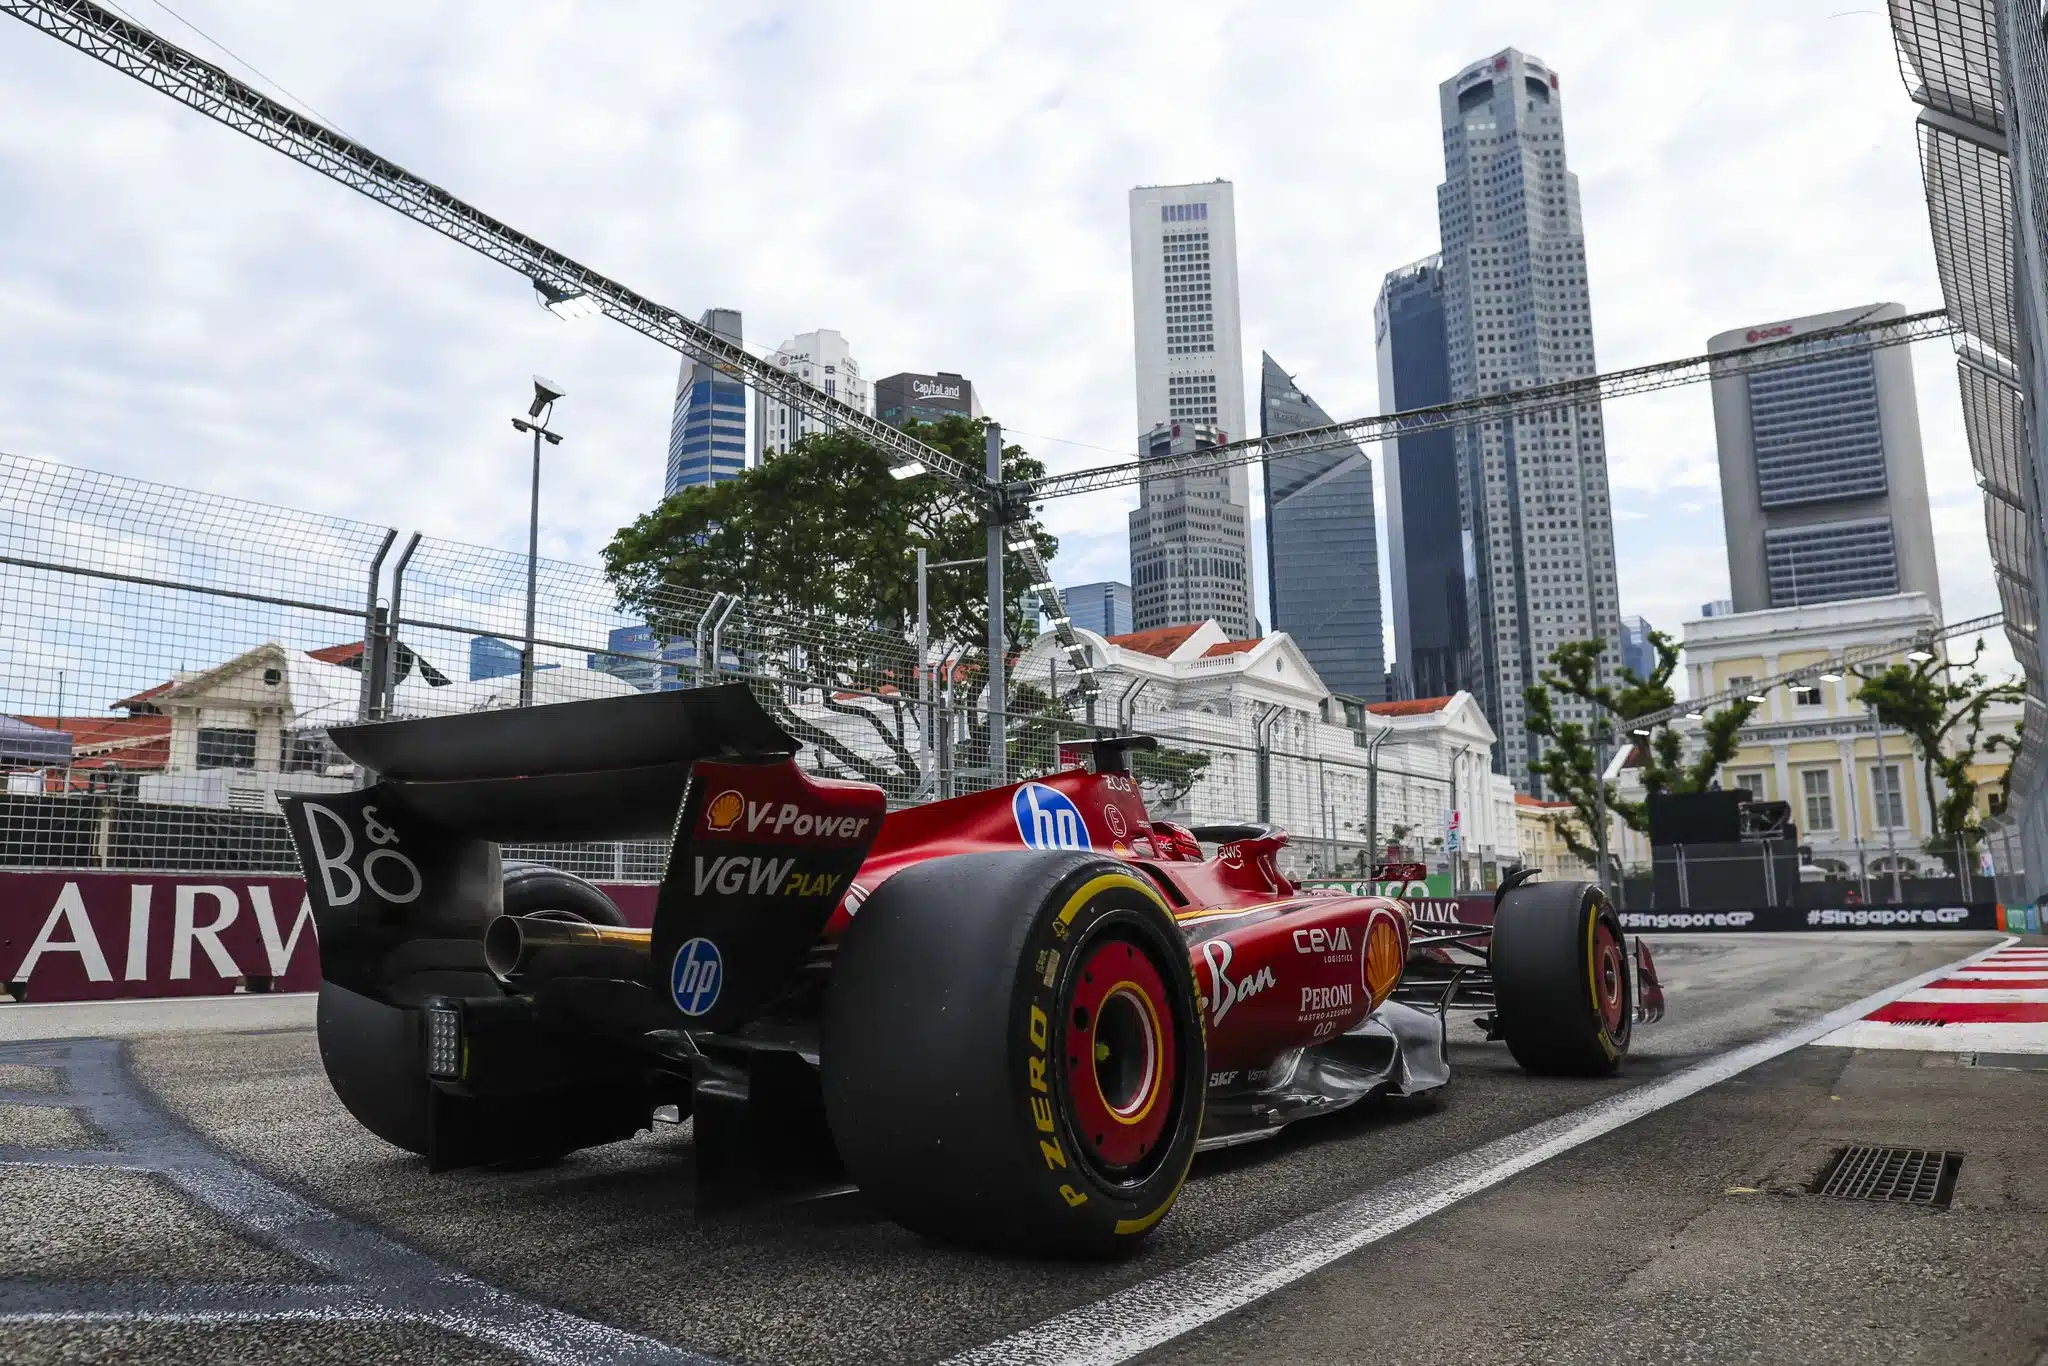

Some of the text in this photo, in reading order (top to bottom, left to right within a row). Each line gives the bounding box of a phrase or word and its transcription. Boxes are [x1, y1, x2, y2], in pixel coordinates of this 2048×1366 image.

[913, 379, 960, 397] CapitaLand
[748, 801, 869, 838] V-Power
[1807, 907, 1969, 926] #SingaporeGP
[1324, 954, 1353, 964] LOGISTICS
[677, 940, 718, 1014] hp
[1300, 983, 1352, 1012] PERONI
[1298, 1012, 1325, 1022] NASTRO
[1209, 1071, 1239, 1087] SKF
